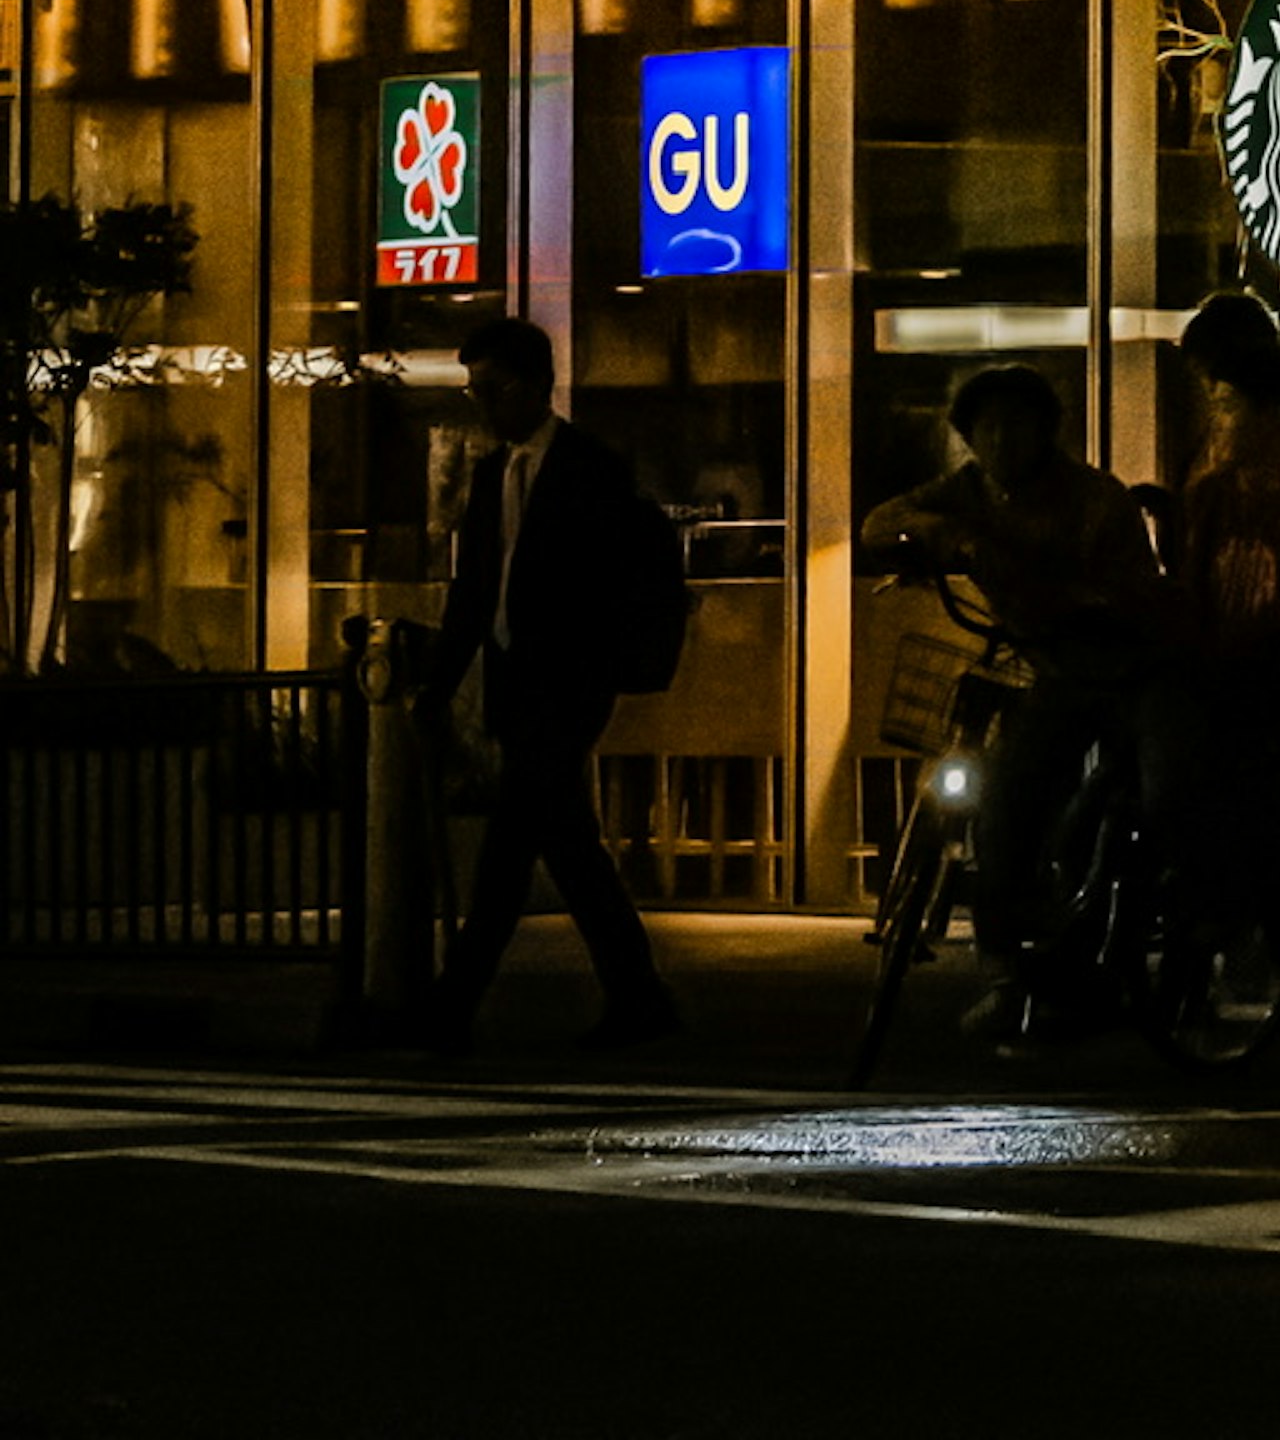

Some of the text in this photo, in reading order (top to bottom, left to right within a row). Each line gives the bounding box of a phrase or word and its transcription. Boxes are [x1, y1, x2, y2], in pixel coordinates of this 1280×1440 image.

[647, 110, 751, 215] GU
[393, 247, 462, 284] ライフ
